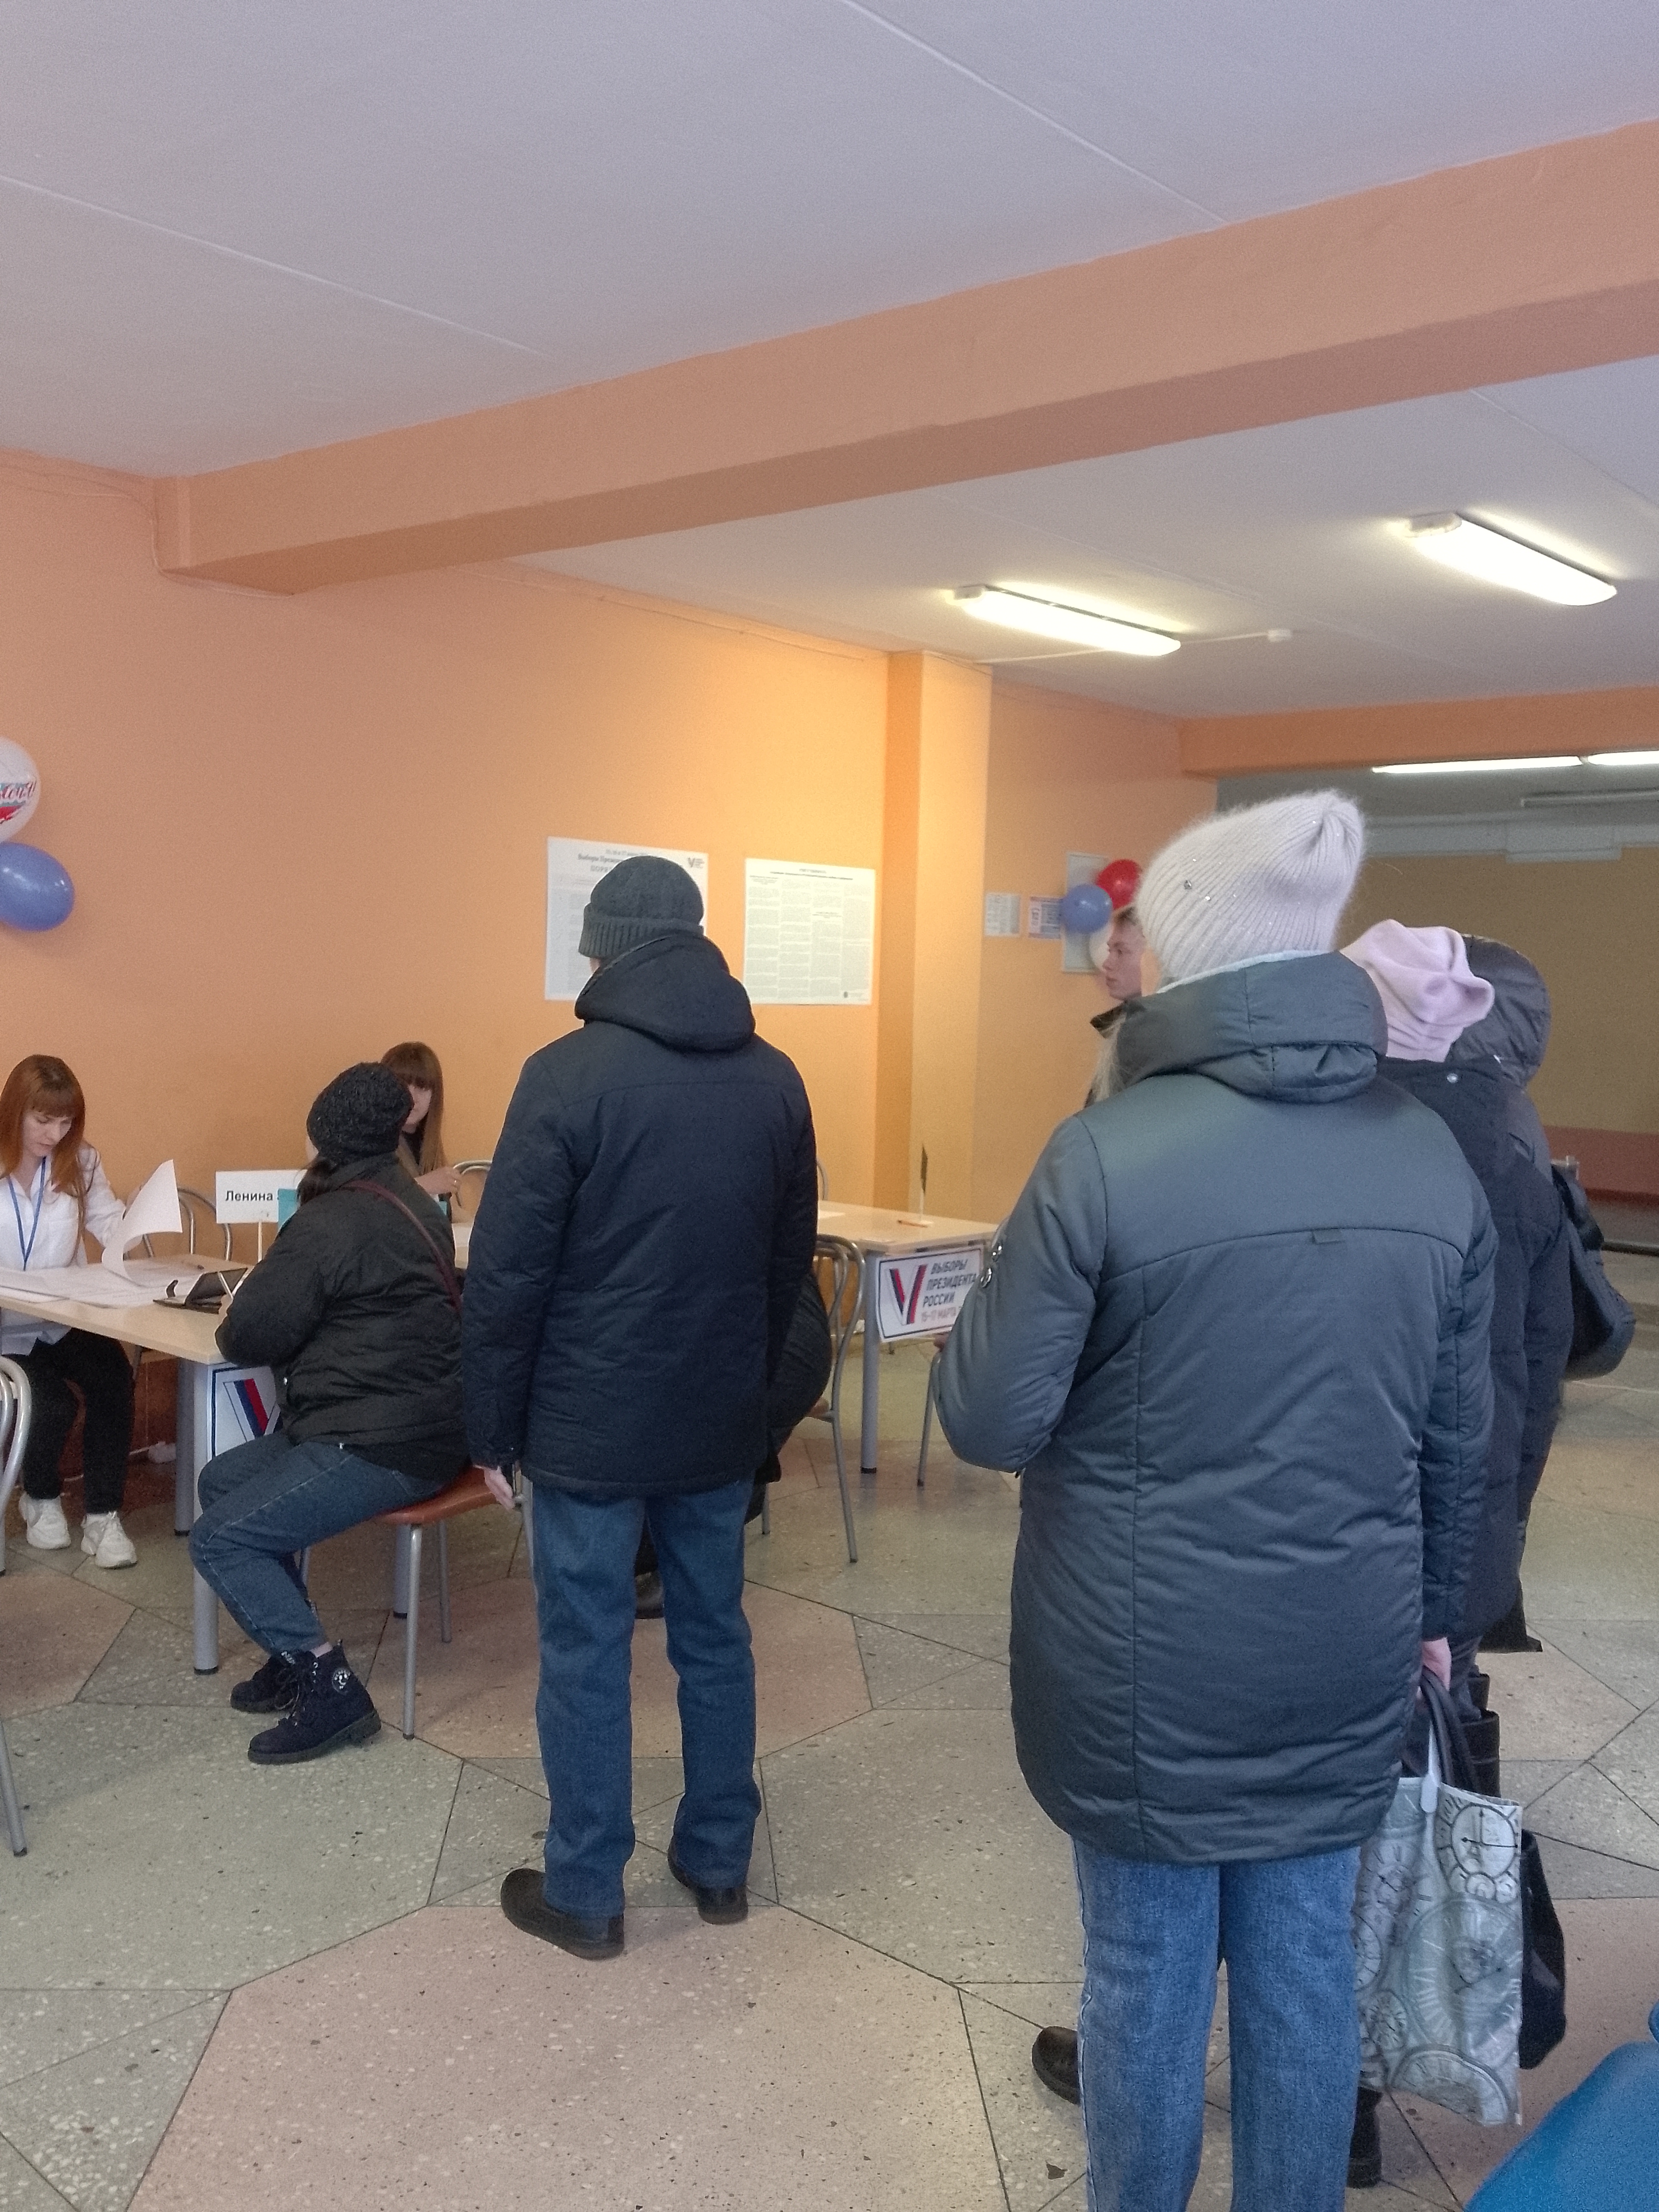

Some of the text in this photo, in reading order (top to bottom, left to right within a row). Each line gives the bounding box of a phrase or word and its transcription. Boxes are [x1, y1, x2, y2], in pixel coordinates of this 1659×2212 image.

[225, 1190, 273, 1201] Ленина
[930, 1259, 968, 1274] ВЫБОРЫ
[926, 1273, 977, 1291] ПРЕЗИДЕНТА
[923, 1291, 955, 1308] РОССИИ
